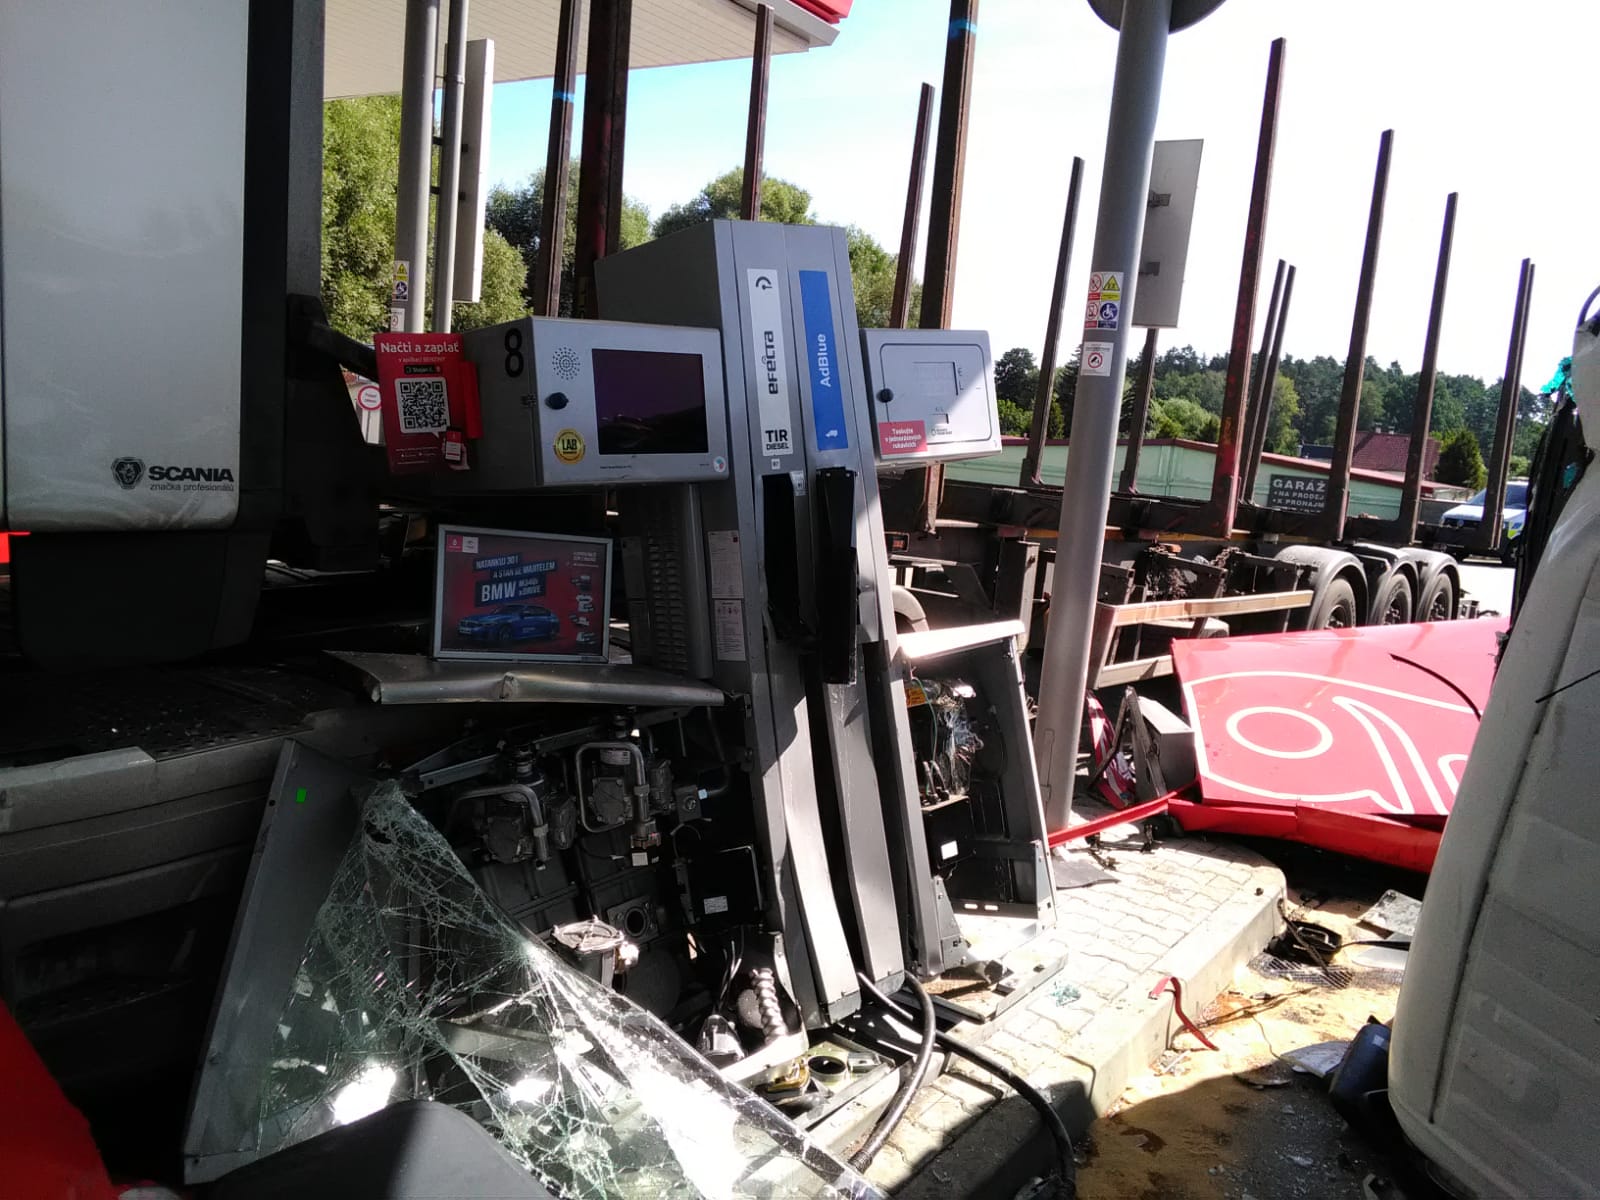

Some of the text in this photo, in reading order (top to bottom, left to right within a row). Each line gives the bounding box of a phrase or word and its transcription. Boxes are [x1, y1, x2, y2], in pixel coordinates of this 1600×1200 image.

[380, 341, 460, 355] Načti a zaplať
[504, 327, 524, 378] 8
[817, 333, 831, 388] AdBlue
[764, 429, 788, 443] TIR
[561, 438, 578, 450] LAB
[766, 442, 789, 451] DIESEL
[148, 465, 234, 482] SCANIA
[1292, 491, 1324, 500] PRODEJ
[481, 581, 517, 602] BMW
